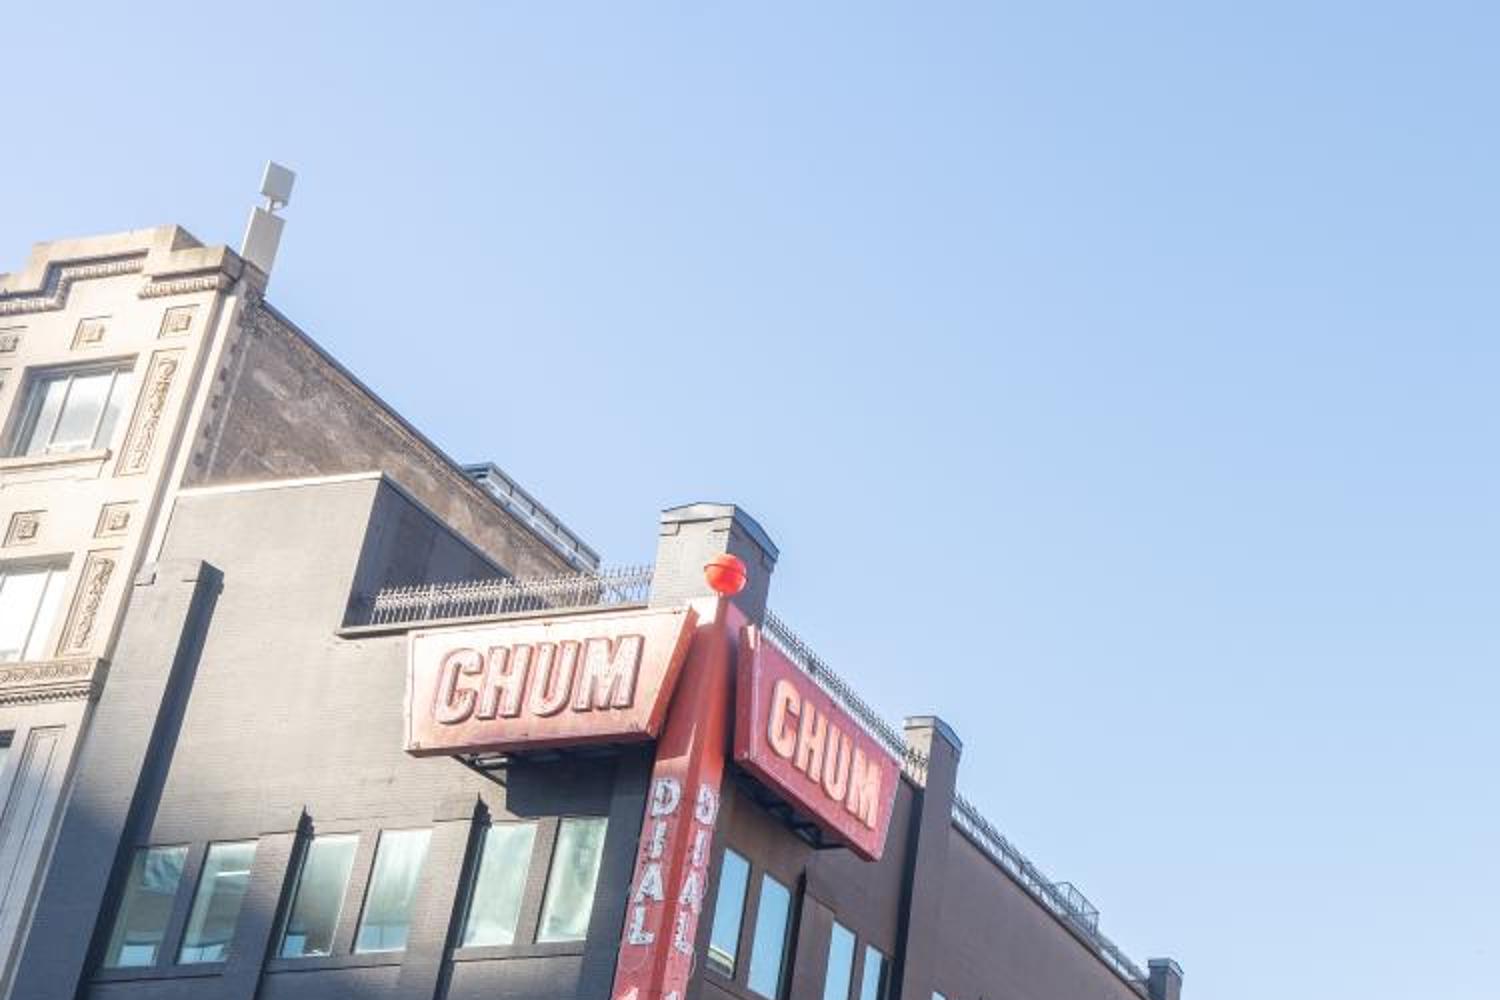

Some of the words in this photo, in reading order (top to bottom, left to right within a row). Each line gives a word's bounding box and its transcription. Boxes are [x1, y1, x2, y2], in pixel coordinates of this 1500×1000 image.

[433, 634, 645, 724] CHUM
[766, 678, 884, 830] CHUM
[626, 777, 682, 946] DIAL
